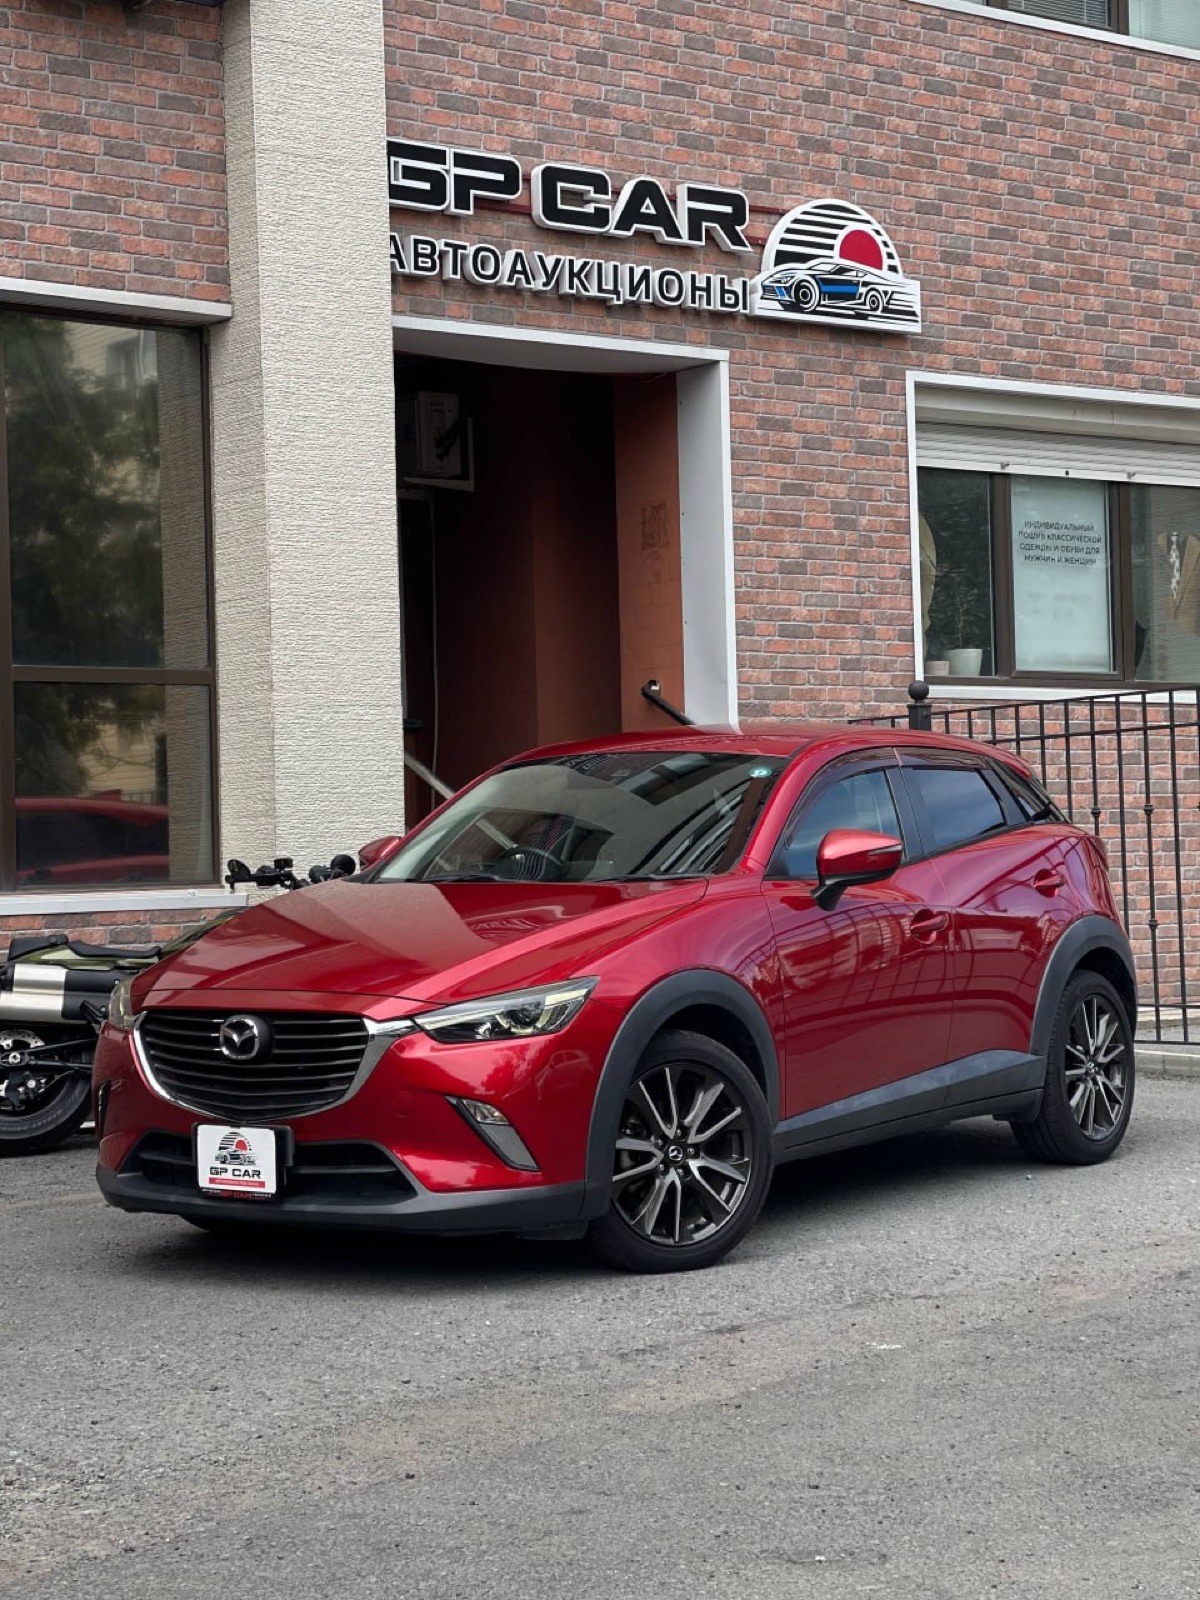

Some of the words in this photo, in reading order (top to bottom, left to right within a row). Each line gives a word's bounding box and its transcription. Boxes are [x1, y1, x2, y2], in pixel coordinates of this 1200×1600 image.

[386, 137, 520, 216] GP
[531, 163, 753, 252] CAR
[389, 231, 751, 314] АВТОАУКЦИОНЫ
[1024, 520, 1095, 532] ИНДИВИДУАЛЬНЫЙ
[1047, 533, 1102, 543] КЛАССИЧЕСКОЙ
[1019, 542, 1052, 552] ОДЕЖДЫ
[1061, 545, 1084, 553] ОБУВИ
[1085, 546, 1100, 555] ДЛЯ
[1024, 554, 1056, 563] МУЖЧИН
[1064, 556, 1097, 566] ЖЕНЩИН
[209, 1166, 228, 1176] GP
[232, 1168, 261, 1179] CAR
